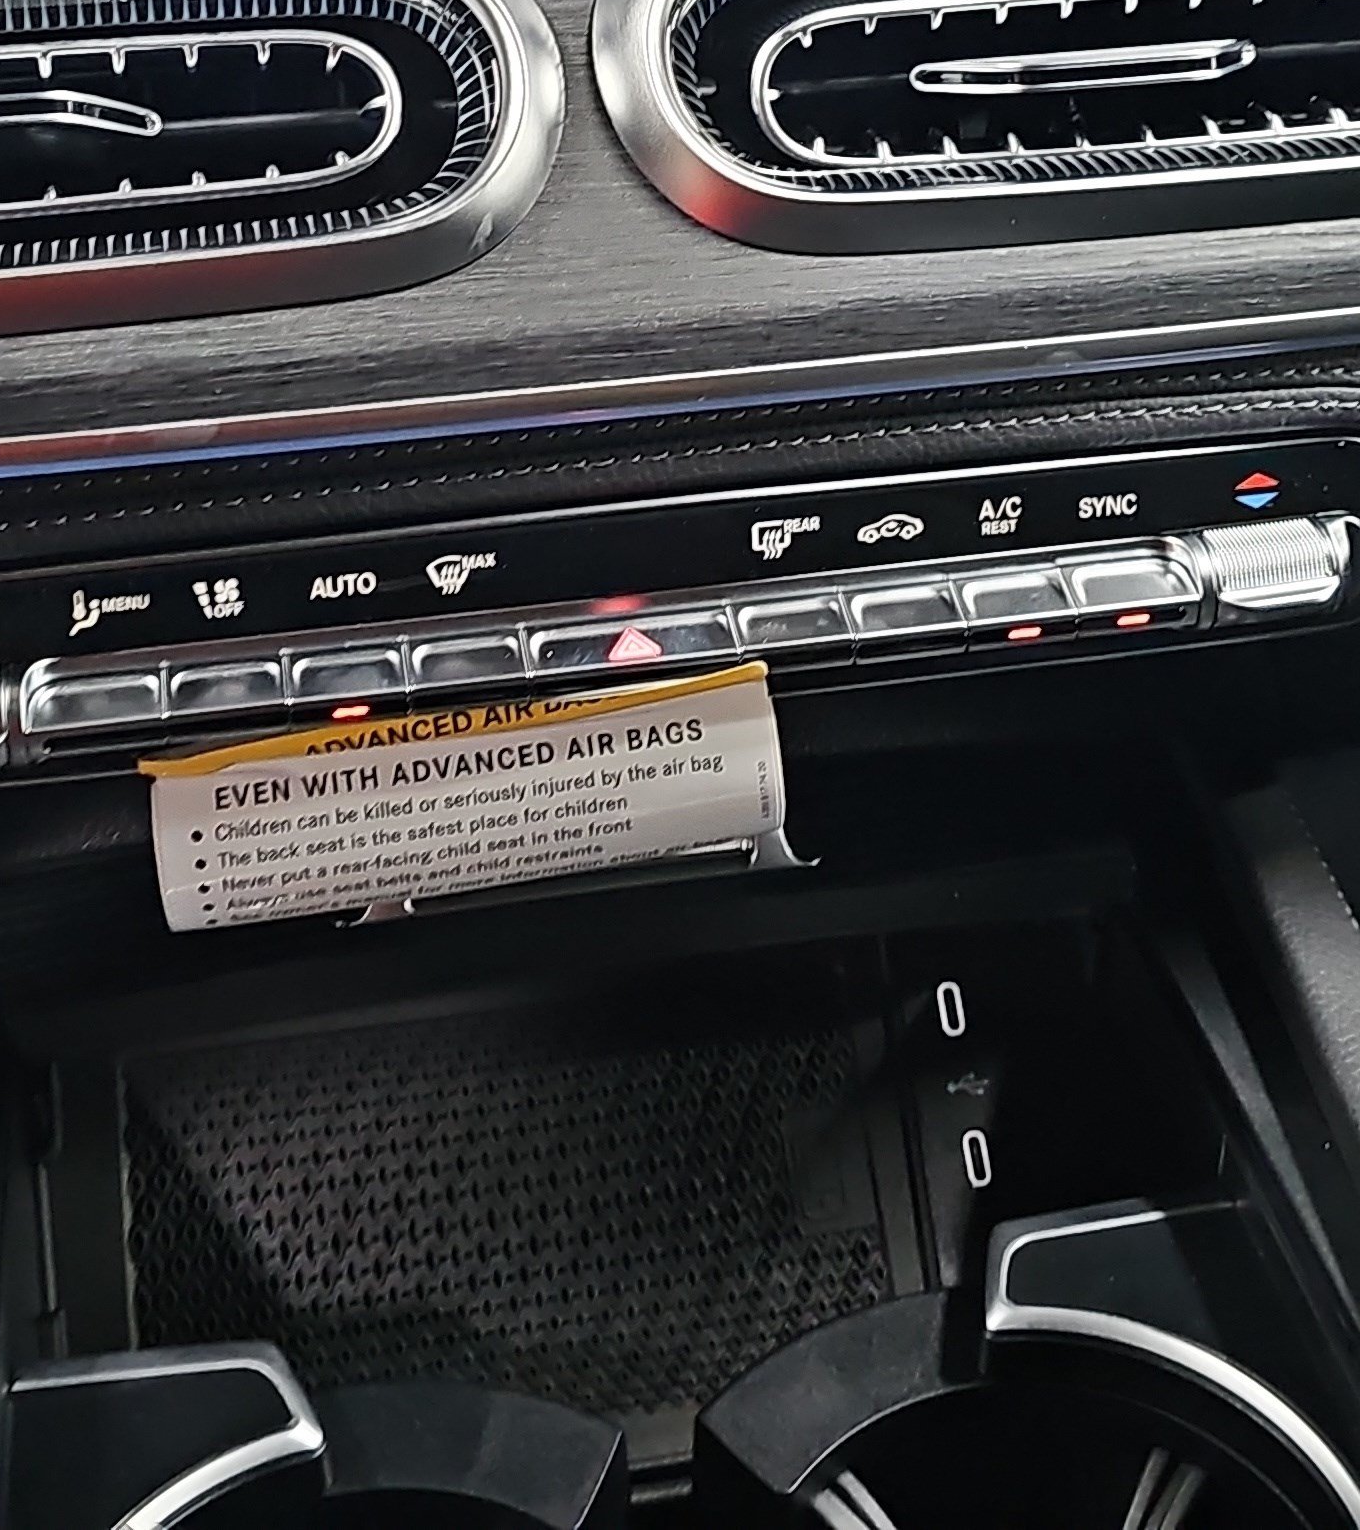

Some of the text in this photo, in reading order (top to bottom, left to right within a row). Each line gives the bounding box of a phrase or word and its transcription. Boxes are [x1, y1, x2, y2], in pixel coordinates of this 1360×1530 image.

[979, 495, 1023, 521] A/C
[1078, 493, 1138, 520] SYNC
[783, 516, 821, 534] REAR
[981, 519, 1018, 537] REST
[461, 552, 497, 570] MAX
[309, 571, 377, 601] AUTO
[101, 594, 151, 614] MENU
[213, 600, 245, 618] OFF
[214, 718, 704, 811] EVEN WITH ADVANCED AIR BAGS
[213, 755, 724, 843] Children can be killed or seriously injured by the air bag
[217, 795, 628, 869] The back seat is the safest place for children
[221, 872, 276, 893] Never
[280, 866, 312, 886] put
[316, 866, 328, 879] a
[436, 839, 481, 860] child
[486, 833, 525, 852] seat
[531, 829, 548, 845] in
[553, 825, 583, 842] the
[587, 818, 633, 838] front
